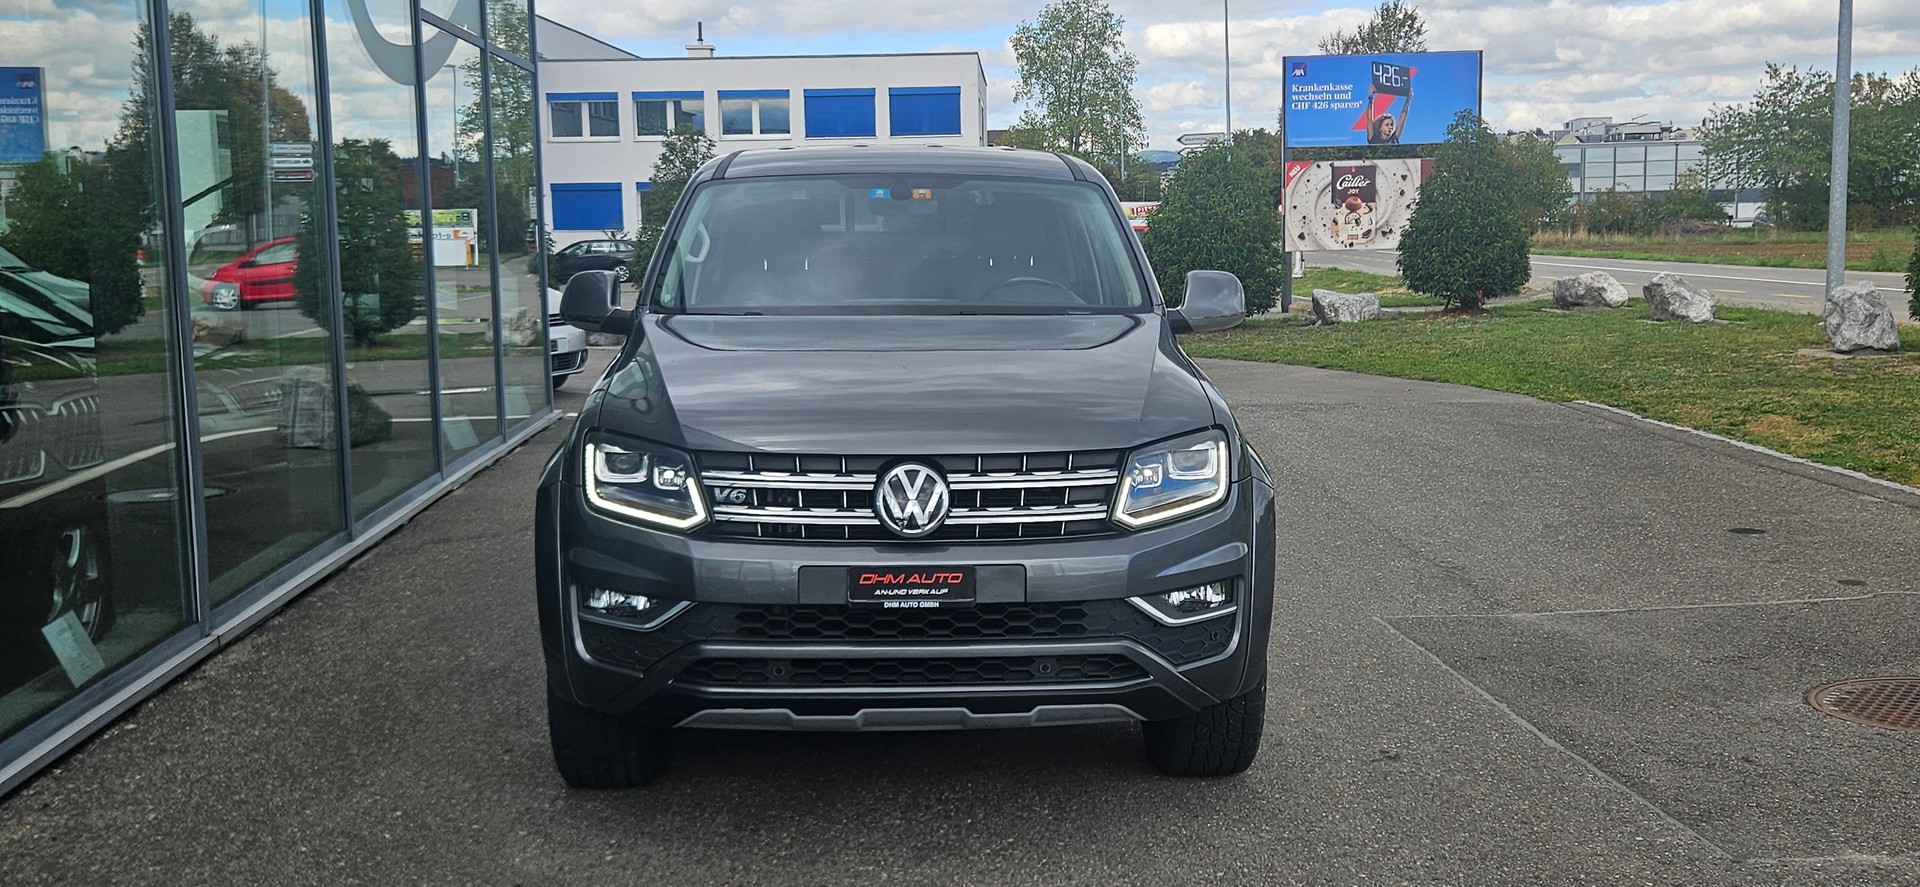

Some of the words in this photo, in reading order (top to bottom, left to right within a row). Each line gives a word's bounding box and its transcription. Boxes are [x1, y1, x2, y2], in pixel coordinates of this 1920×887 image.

[1373, 63, 1408, 88] 426.-
[1292, 83, 1353, 92] Krankenkasse
[1292, 92, 1332, 101] wechseln
[1334, 91, 1351, 100] und
[1291, 101, 1310, 110] CHF
[1312, 101, 1329, 110] 426
[1336, 174, 1371, 190] Cailler
[713, 487, 748, 504] V6
[859, 573, 906, 585] DHM
[906, 572, 963, 584] AUTO
[884, 601, 900, 609] DHM
